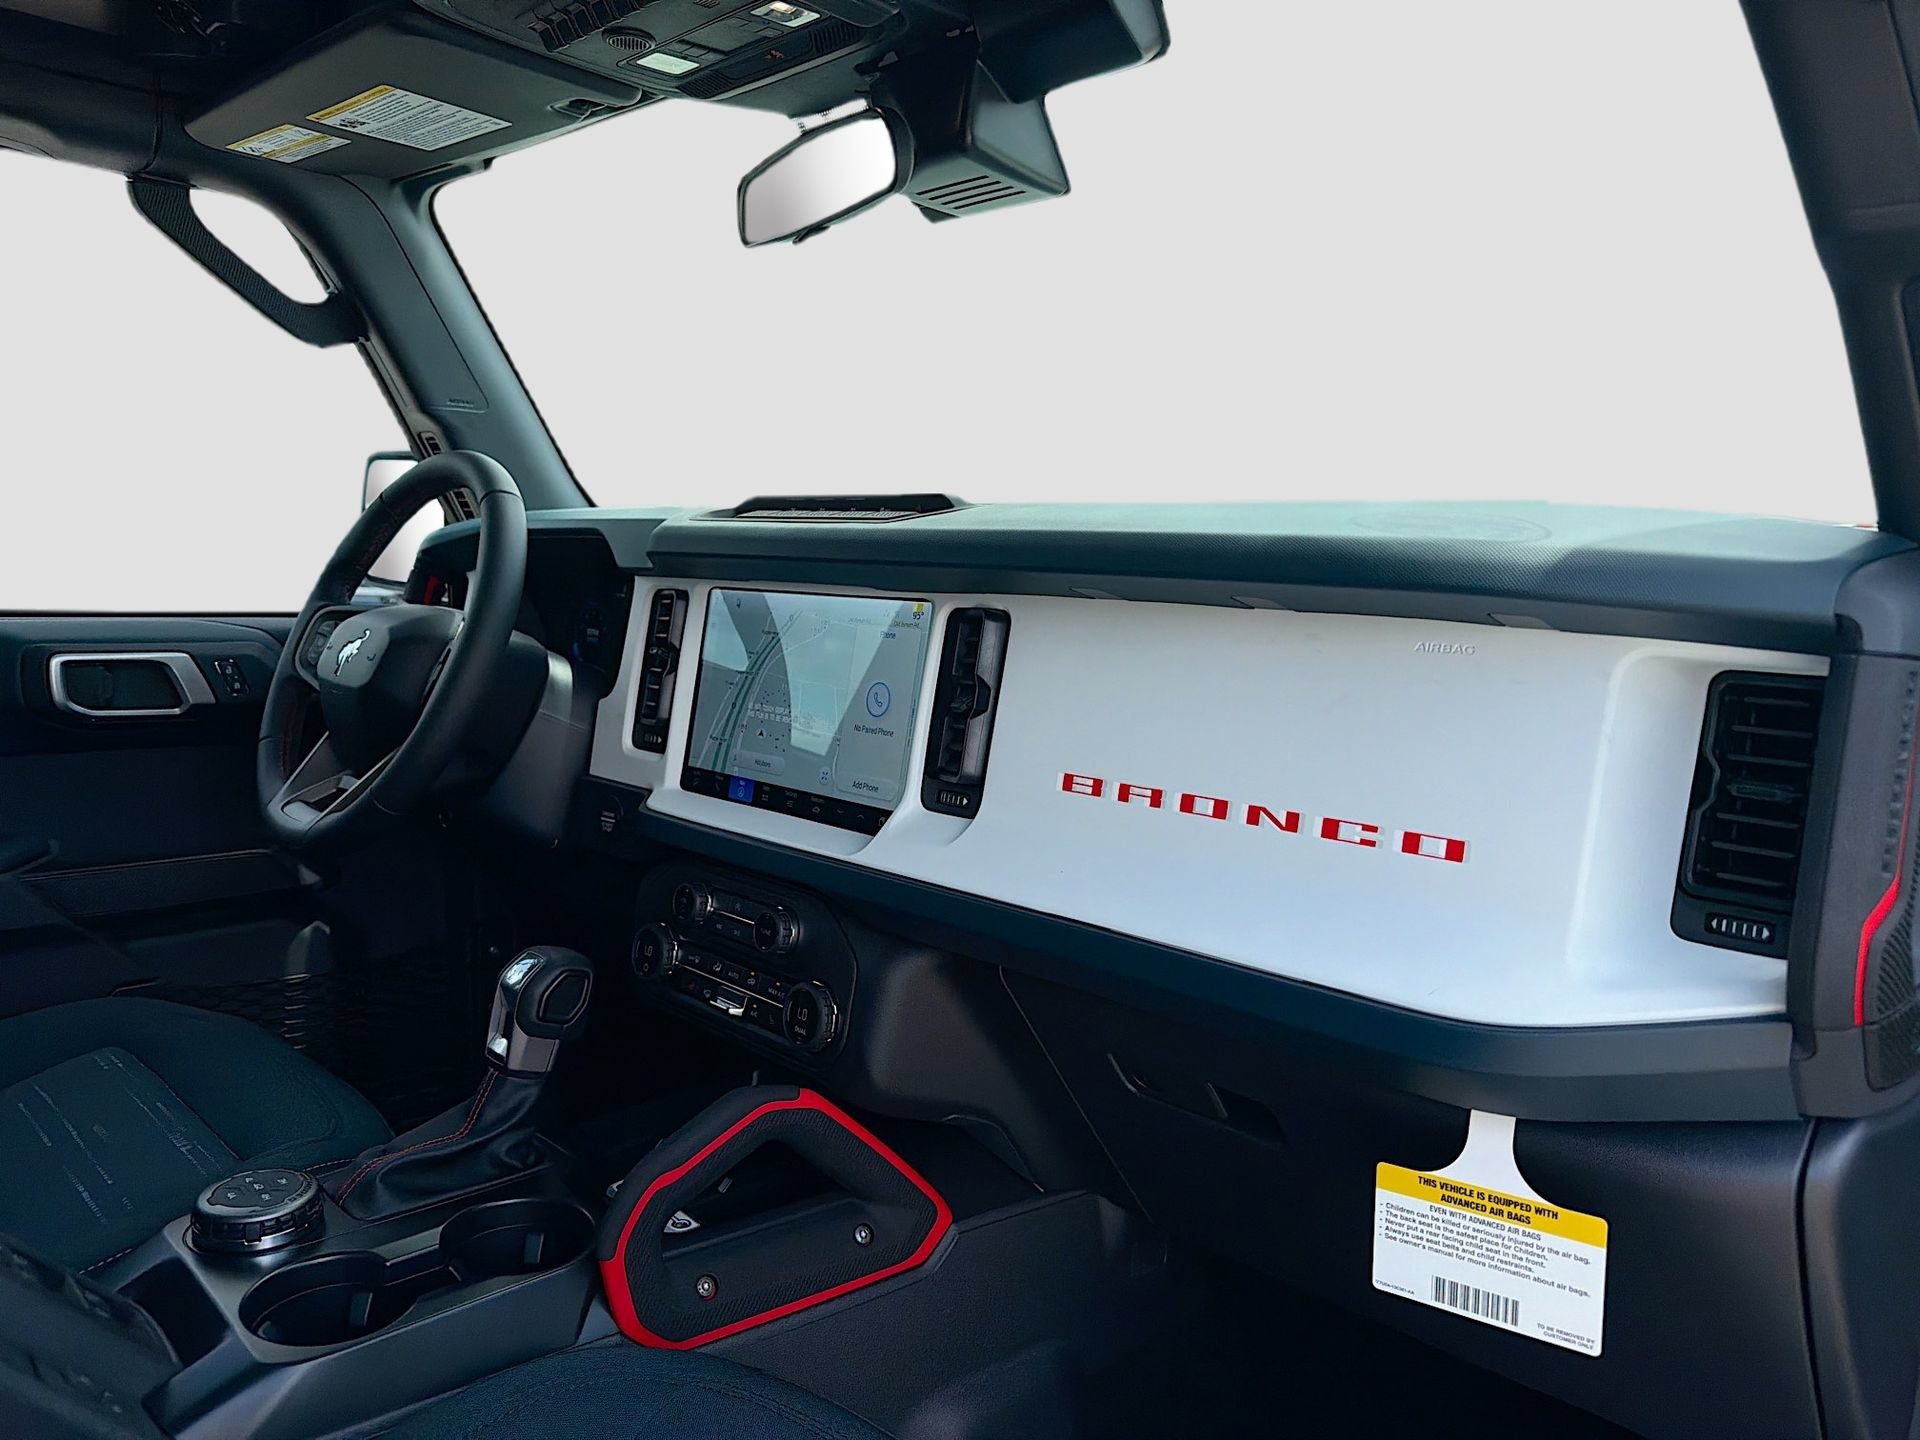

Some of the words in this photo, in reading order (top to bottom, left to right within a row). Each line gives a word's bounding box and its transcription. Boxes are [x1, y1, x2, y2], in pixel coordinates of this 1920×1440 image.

[1414, 642, 1476, 656] AIRBAG
[854, 724, 862, 732] No
[862, 726, 877, 735] Paired
[878, 728, 894, 738] Phone
[852, 780, 862, 789] Add
[863, 782, 879, 792] Phone
[1057, 772, 1470, 863] BRONCO
[1418, 1176, 1437, 1188] THIS
[1440, 1182, 1474, 1198] VEHICLE
[1476, 1190, 1486, 1200] IS
[1488, 1194, 1532, 1212] EQUIPPED
[1534, 1206, 1559, 1220] WITH
[1440, 1194, 1486, 1212] ADVANCED
[1489, 1207, 1504, 1218] AIR
[1507, 1211, 1531, 1225] BAGS
[1385, 1217, 1405, 1228] Never
[1406, 1224, 1418, 1233] put
[1426, 1229, 1440, 1238] rear
[1441, 1232, 1464, 1246] facing
[1465, 1238, 1484, 1250] child
[1485, 1245, 1501, 1256] seat
[1502, 1250, 1510, 1258] in
[1511, 1252, 1524, 1262] the
[1525, 1257, 1546, 1269] front.
[1386, 1202, 1415, 1216] Children
[1416, 1210, 1429, 1220] can
[1431, 1214, 1440, 1222] be
[1442, 1216, 1461, 1228] killed
[1462, 1223, 1470, 1231] or
[1472, 1225, 1506, 1242] seriously
[1508, 1236, 1534, 1250] injured
[1536, 1243, 1545, 1253] by
[1547, 1246, 1560, 1256] the
[1562, 1250, 1572, 1259] air
[1573, 1254, 1591, 1265] bag.
[1386, 1210, 1398, 1219] The
[1400, 1214, 1416, 1224] back
[1418, 1219, 1433, 1229] seat
[1435, 1223, 1441, 1231] is
[1442, 1225, 1454, 1234] the
[1456, 1228, 1478, 1241] safest
[1480, 1234, 1499, 1247] place
[1501, 1242, 1512, 1250] for
[1514, 1246, 1548, 1261] Children.
[1429, 1205, 1447, 1216] EVEN
[1449, 1210, 1467, 1221] WITH
[1468, 1214, 1506, 1232] ADVANCED
[1507, 1226, 1520, 1235] AIR
[1522, 1230, 1541, 1241] BAGS
[1384, 1225, 1409, 1237] Always
[1411, 1233, 1424, 1242] use
[1426, 1236, 1440, 1247] seat
[1442, 1240, 1460, 1252] belts
[1461, 1246, 1475, 1256] and
[1477, 1250, 1494, 1263] child
[1497, 1257, 1535, 1273] restraints.
[1384, 1233, 1398, 1242] See
[1399, 1237, 1426, 1250] owner's
[1428, 1246, 1454, 1258] manual
[1455, 1252, 1466, 1261] for
[1467, 1257, 1486, 1268] more
[1488, 1260, 1531, 1280] information
[1533, 1276, 1555, 1288] about
[1556, 1282, 1567, 1290] air
[1569, 1285, 1591, 1297] bags.
[1544, 1331, 1576, 1344] CUSTOMER
[1577, 1341, 1594, 1350] ONLY
[1556, 1329, 1585, 1341] REMOVED
